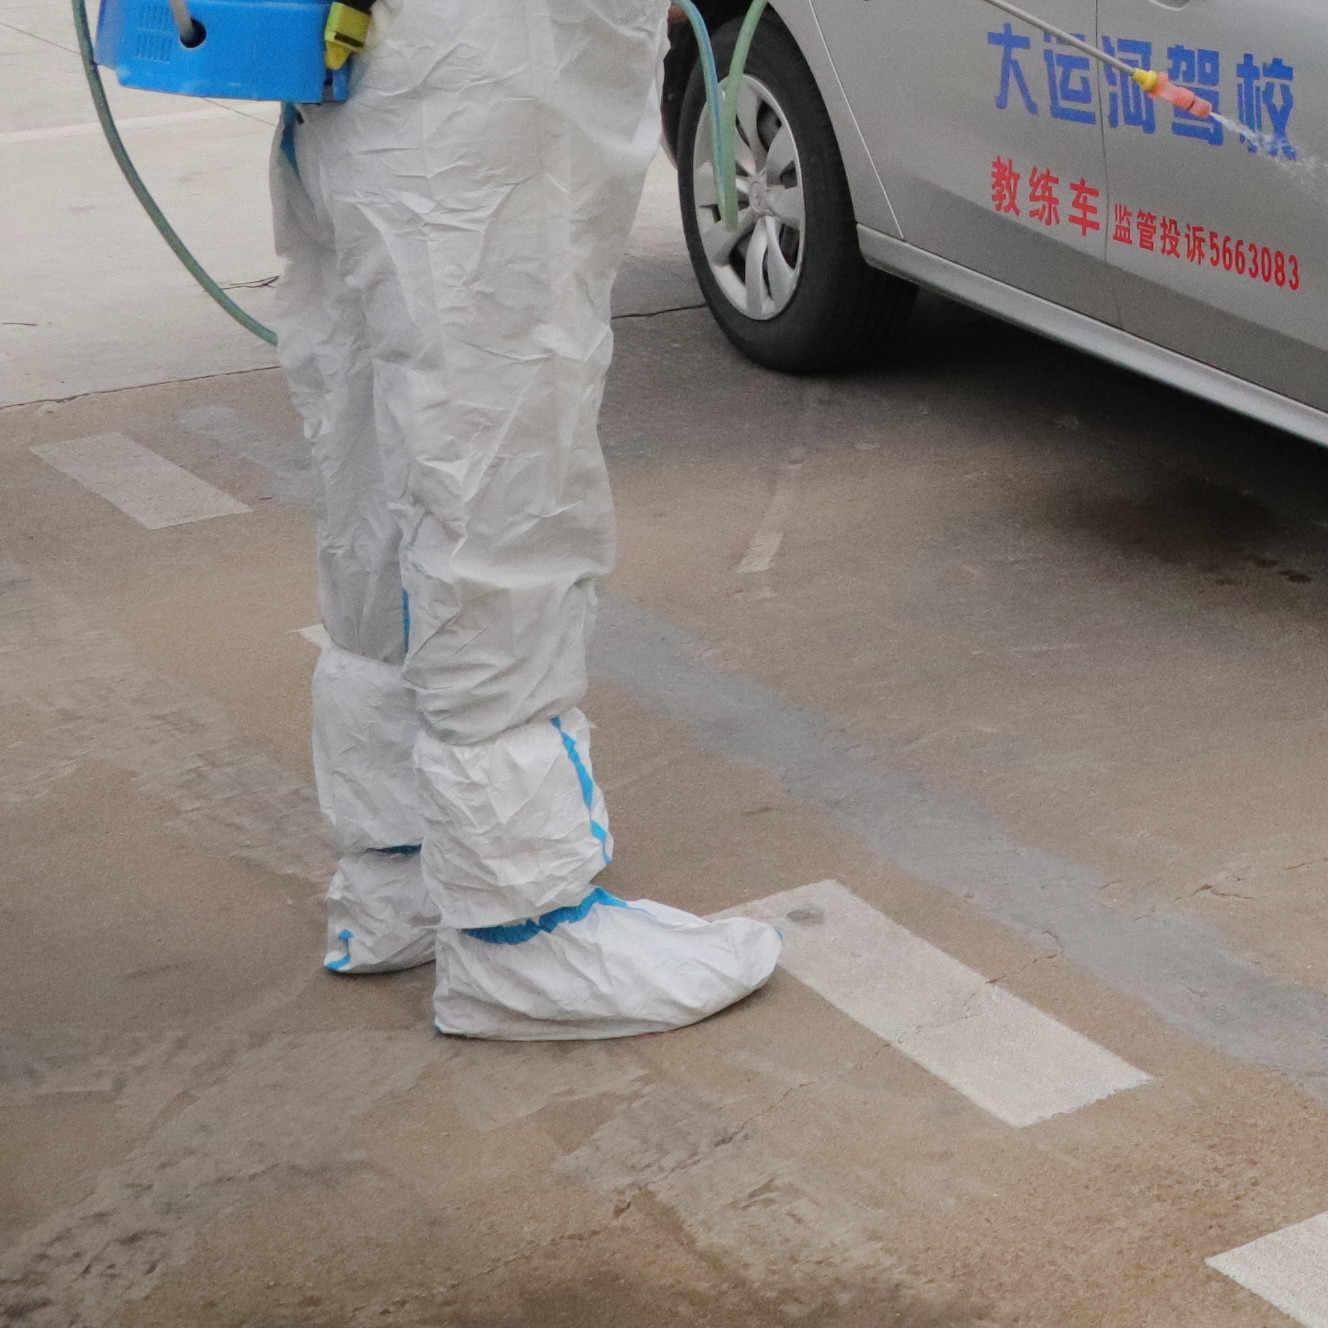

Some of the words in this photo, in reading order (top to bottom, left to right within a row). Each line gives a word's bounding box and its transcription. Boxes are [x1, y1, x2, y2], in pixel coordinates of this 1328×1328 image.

[987, 22, 1298, 160] 大运河驾校
[991, 155, 1101, 237] 教练车
[1112, 203, 1301, 291] 监管投诉5663083
